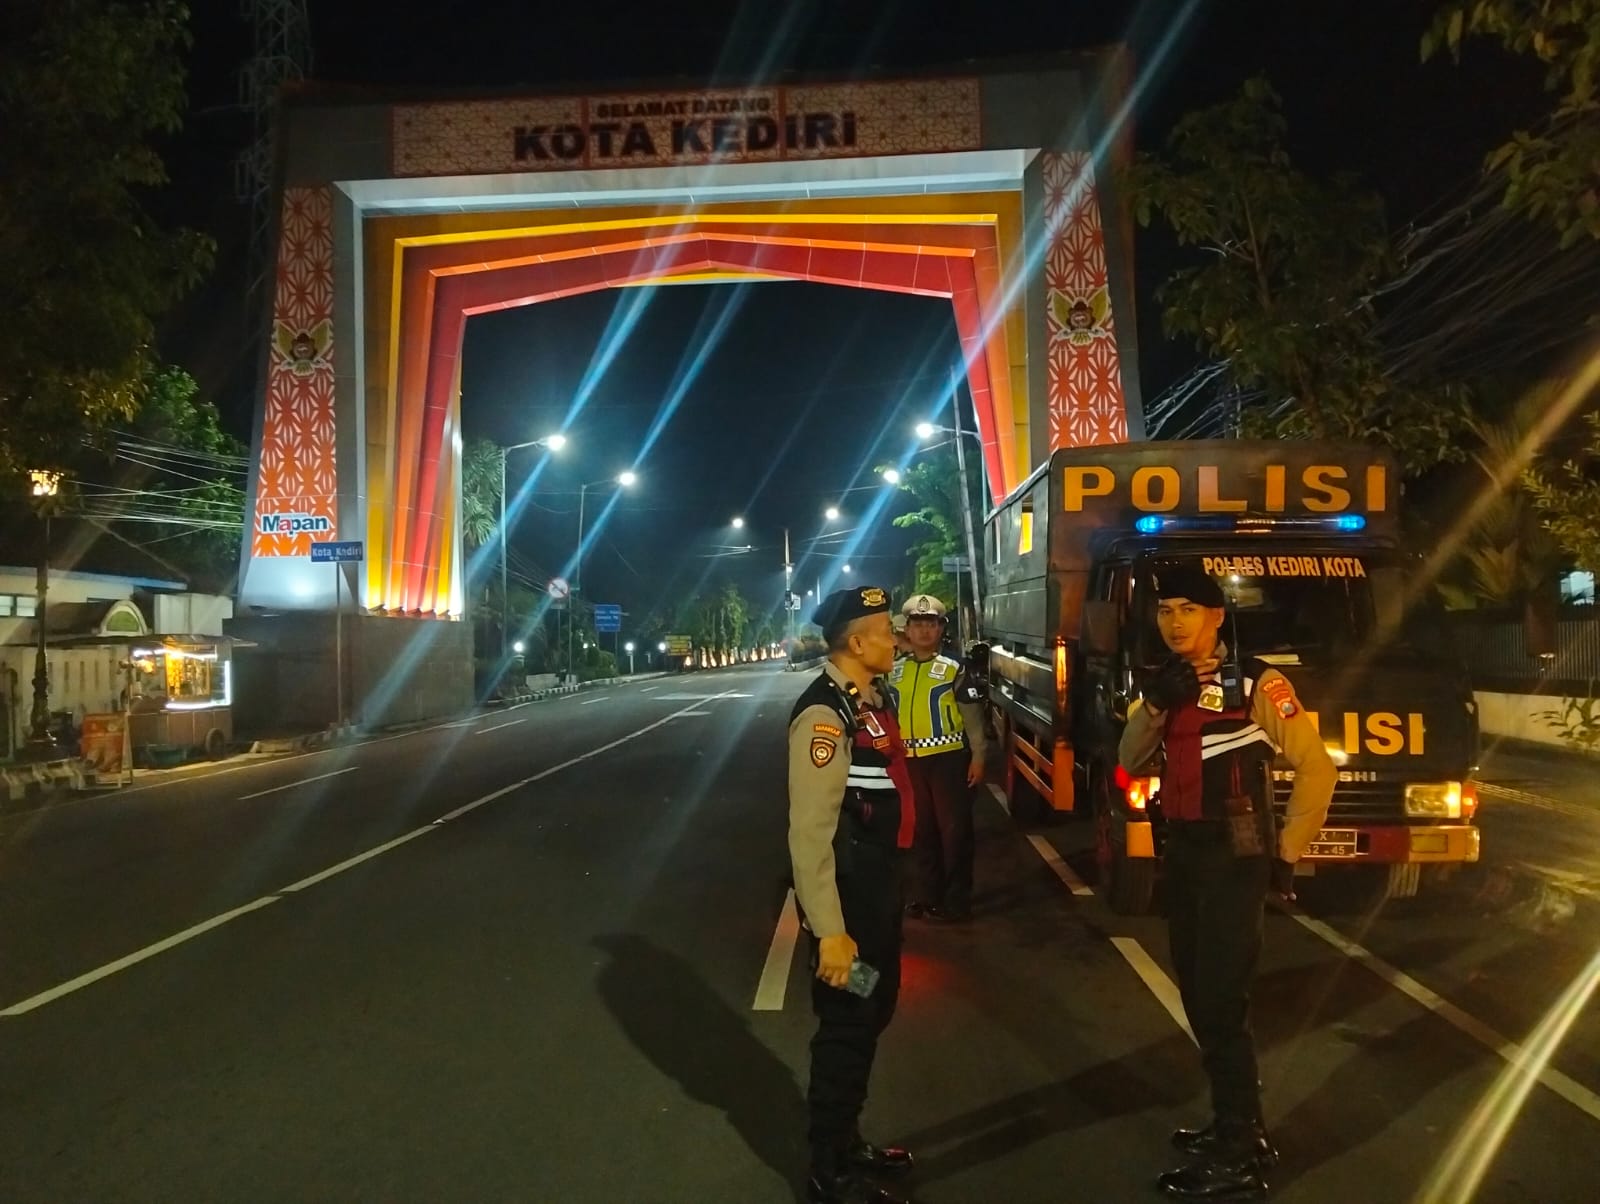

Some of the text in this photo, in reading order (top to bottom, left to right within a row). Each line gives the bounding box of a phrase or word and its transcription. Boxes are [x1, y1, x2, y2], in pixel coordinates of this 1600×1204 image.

[598, 97, 771, 118] SELAMAT DATANG
[514, 112, 856, 160] KOTA KEDIRI
[1064, 465, 1386, 512] POLISI
[262, 515, 328, 535] Mapan
[1202, 556, 1367, 578] POLRES KEDIRI KOTA
